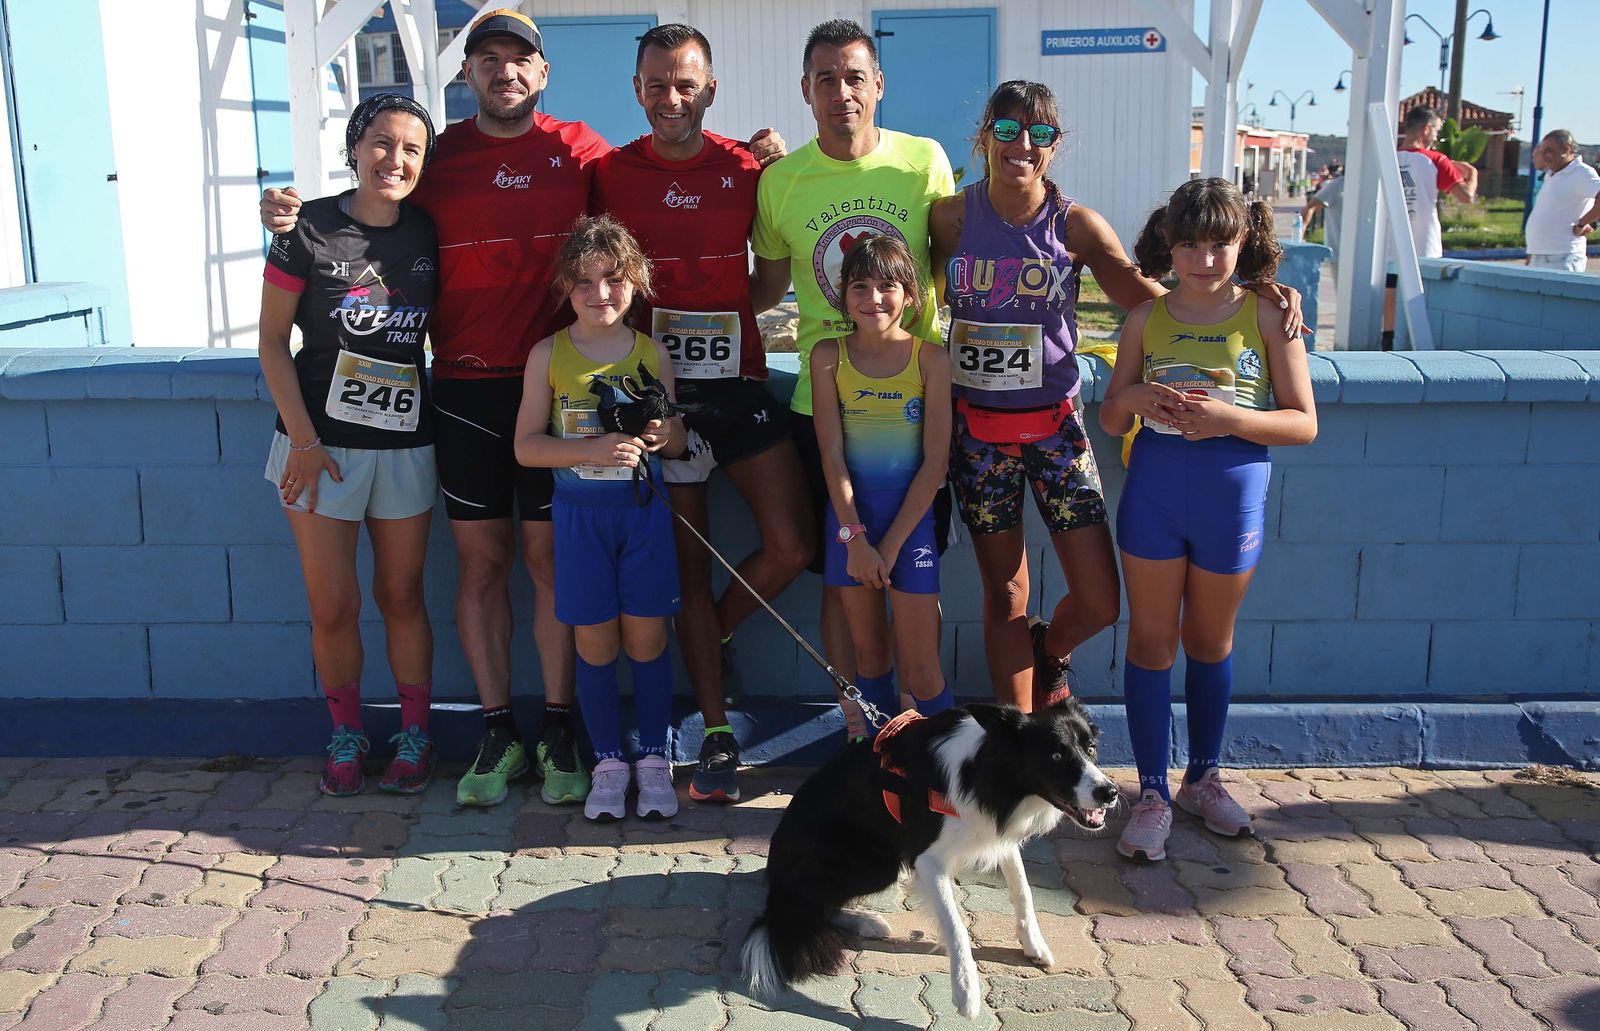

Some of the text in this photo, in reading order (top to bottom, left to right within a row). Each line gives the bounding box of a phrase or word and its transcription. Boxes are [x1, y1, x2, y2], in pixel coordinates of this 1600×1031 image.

[1046, 35, 1140, 48] PRIMEROS AUXILIOS
[501, 175, 532, 185] PEAKY
[671, 195, 701, 204] PEAKY
[805, 195, 909, 232] Valentina
[818, 216, 878, 249] Investigación
[354, 304, 430, 329] PEAKY
[386, 331, 418, 343] TRAIL
[668, 327, 688, 335] CIUDAD
[696, 328, 724, 336] ALGECIRAS
[967, 338, 1023, 348] CIUDAD DE ALGECIRAS
[1197, 334, 1227, 343] rasán
[662, 334, 731, 361] 266
[960, 345, 1031, 373] 324
[354, 372, 377, 384] CIUDAD
[384, 378, 411, 388] ALGECIRAS
[1183, 380, 1215, 388] ALGECIRAS
[340, 378, 415, 413] 246
[877, 390, 902, 399] rasán
[576, 426, 597, 434] CIUDAD
[915, 558, 933, 568] rasán
